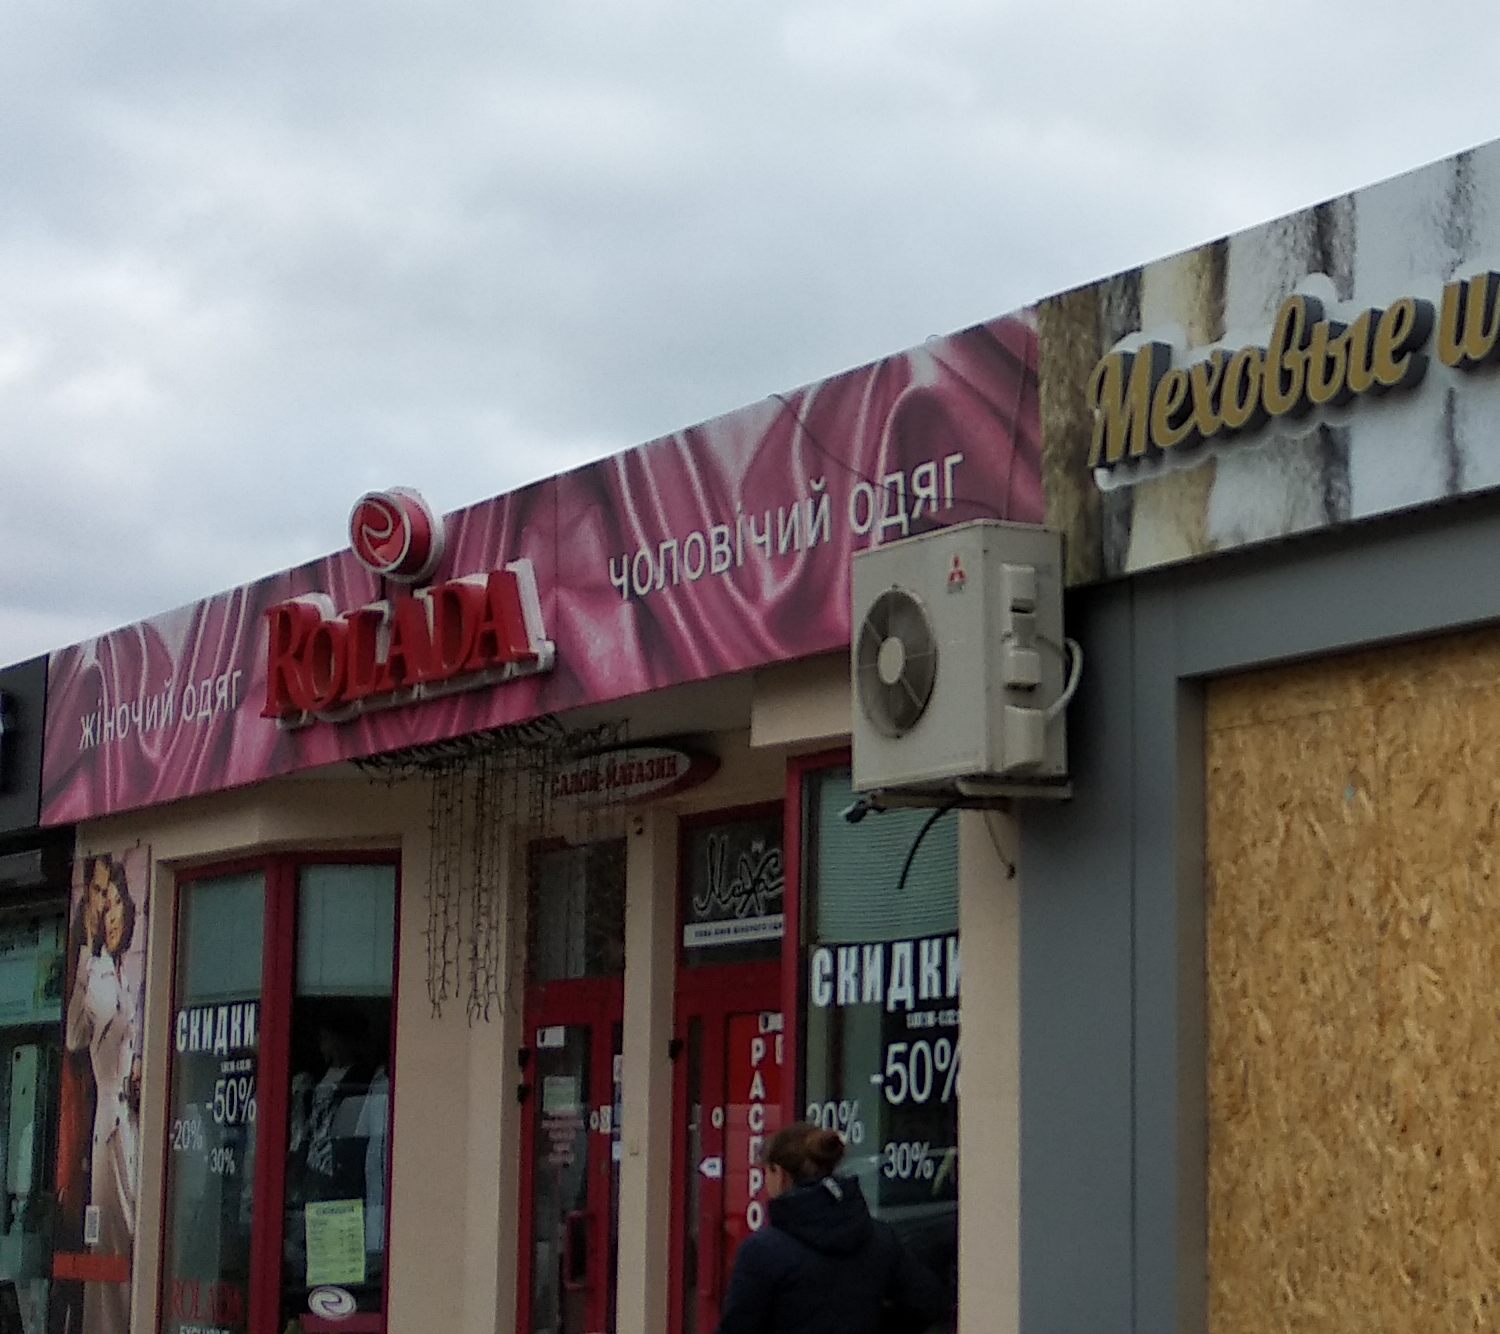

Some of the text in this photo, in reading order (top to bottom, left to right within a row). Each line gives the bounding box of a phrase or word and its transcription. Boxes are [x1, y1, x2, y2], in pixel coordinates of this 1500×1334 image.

[1086, 293, 1434, 470] Меховые
[608, 450, 965, 601] чоловічий одяг
[259, 566, 547, 720] ROLADA
[78, 669, 243, 751] жіночий одяг
[810, 936, 958, 1013] СКИДКИ
[175, 1002, 256, 1056] СКИДКИ
[205, 1075, 257, 1125] -50%
